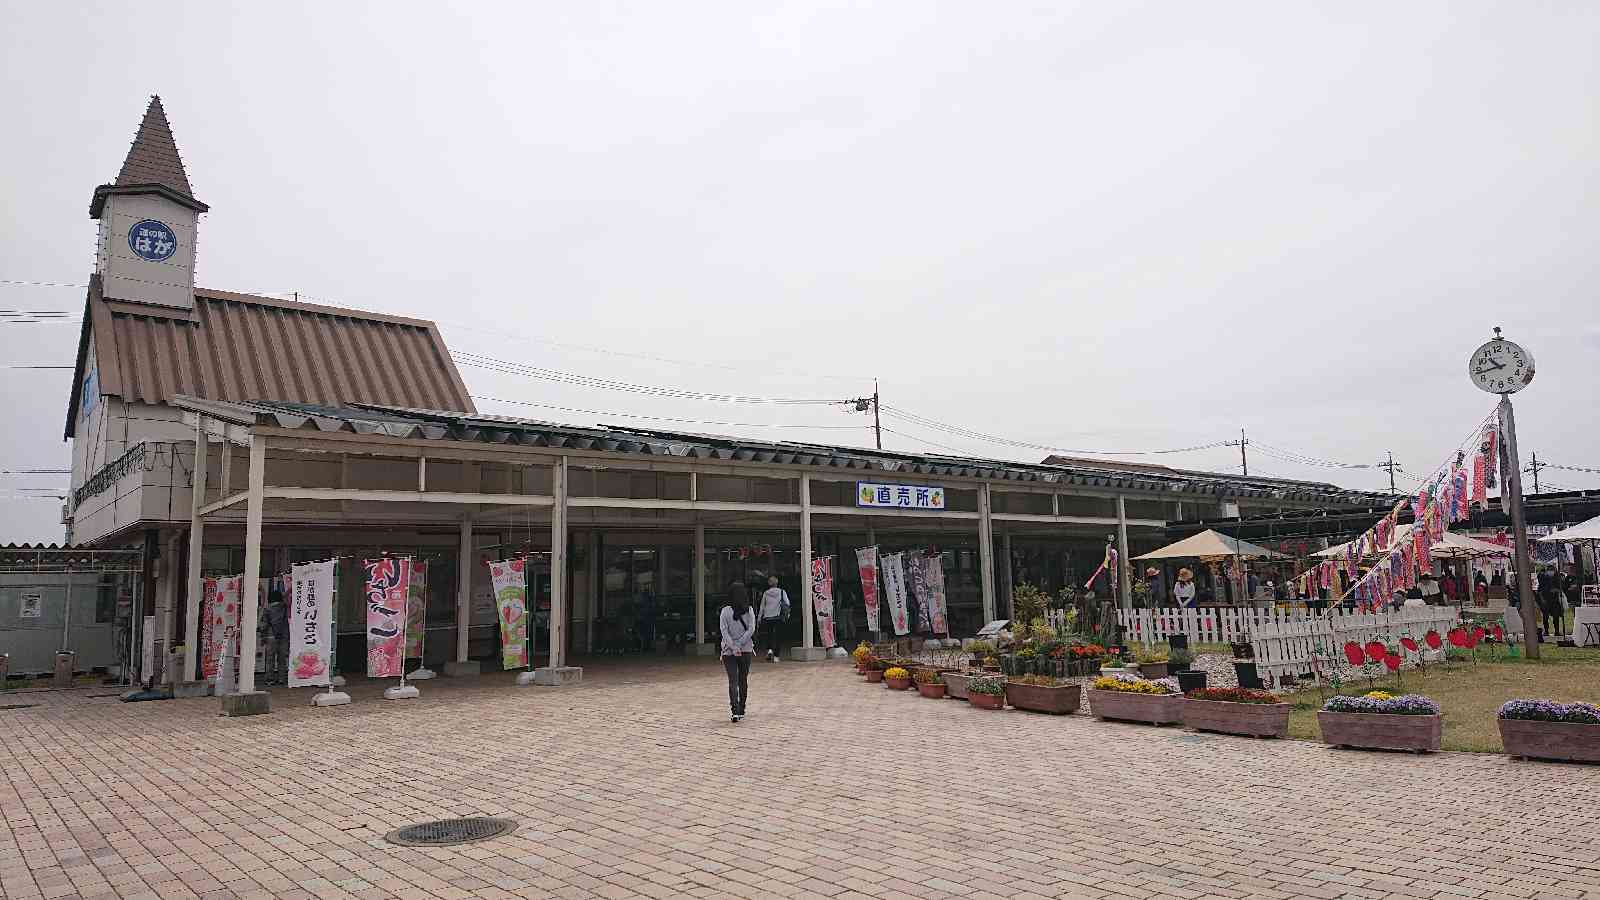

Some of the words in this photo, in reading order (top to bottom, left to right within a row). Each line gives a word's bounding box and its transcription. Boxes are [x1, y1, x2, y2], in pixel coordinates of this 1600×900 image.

[138, 227, 168, 240] 道の駅
[135, 236, 174, 255] はが
[1493, 345, 1502, 353] 12
[1516, 359, 1523, 368] 3
[1498, 380, 1504, 388] 6
[877, 486, 929, 507] 直売所
